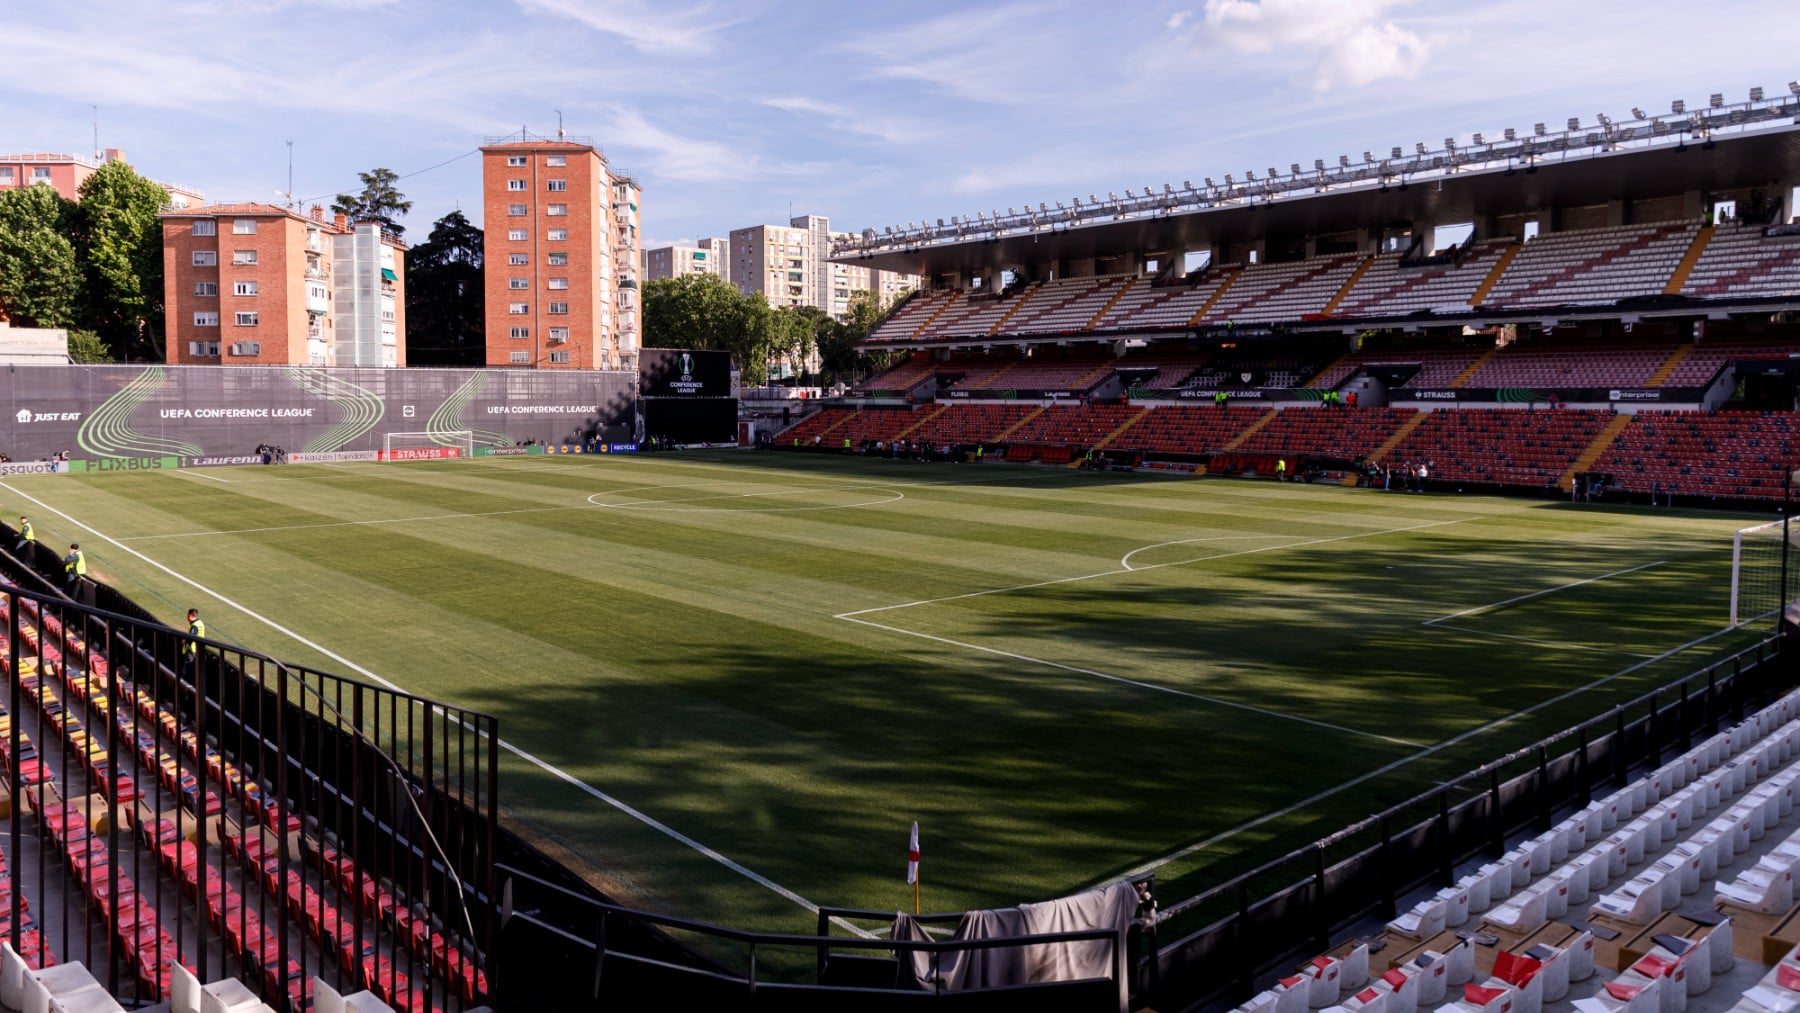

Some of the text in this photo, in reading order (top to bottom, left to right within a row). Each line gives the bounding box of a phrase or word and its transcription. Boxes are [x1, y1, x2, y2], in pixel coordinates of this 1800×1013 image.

[160, 408, 313, 418] UEFA CONFERENCE LEAGUE
[487, 406, 510, 414] UEFA
[566, 405, 596, 413] LEAGUE
[34, 412, 81, 422] JUST EAT
[304, 453, 332, 461] kaizen
[397, 449, 441, 458] STRAUSS
